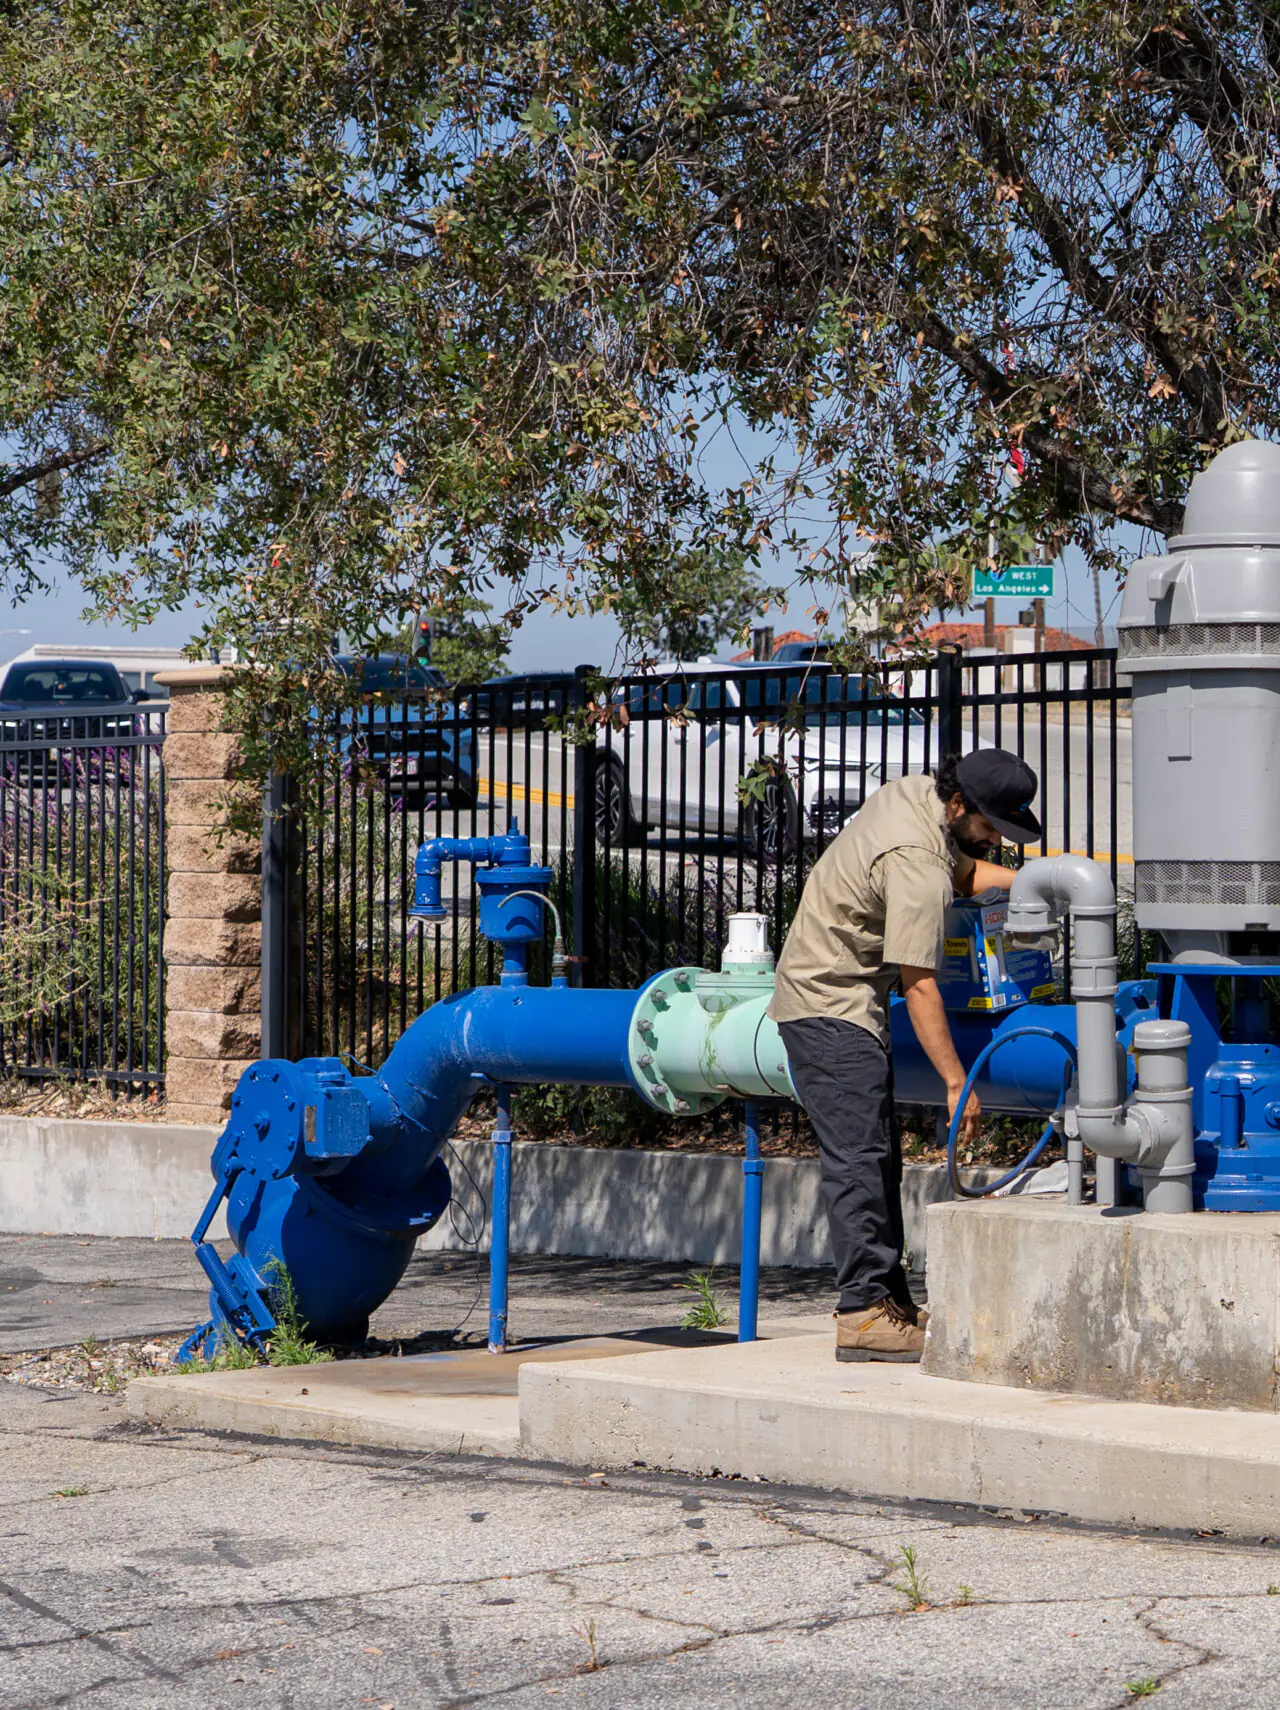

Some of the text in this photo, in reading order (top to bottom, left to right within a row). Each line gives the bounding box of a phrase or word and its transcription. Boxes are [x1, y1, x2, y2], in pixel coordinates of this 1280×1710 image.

[1012, 571, 1037, 580] WEST
[976, 584, 1036, 595] Los Angeles
[984, 912, 1005, 924] HDX
